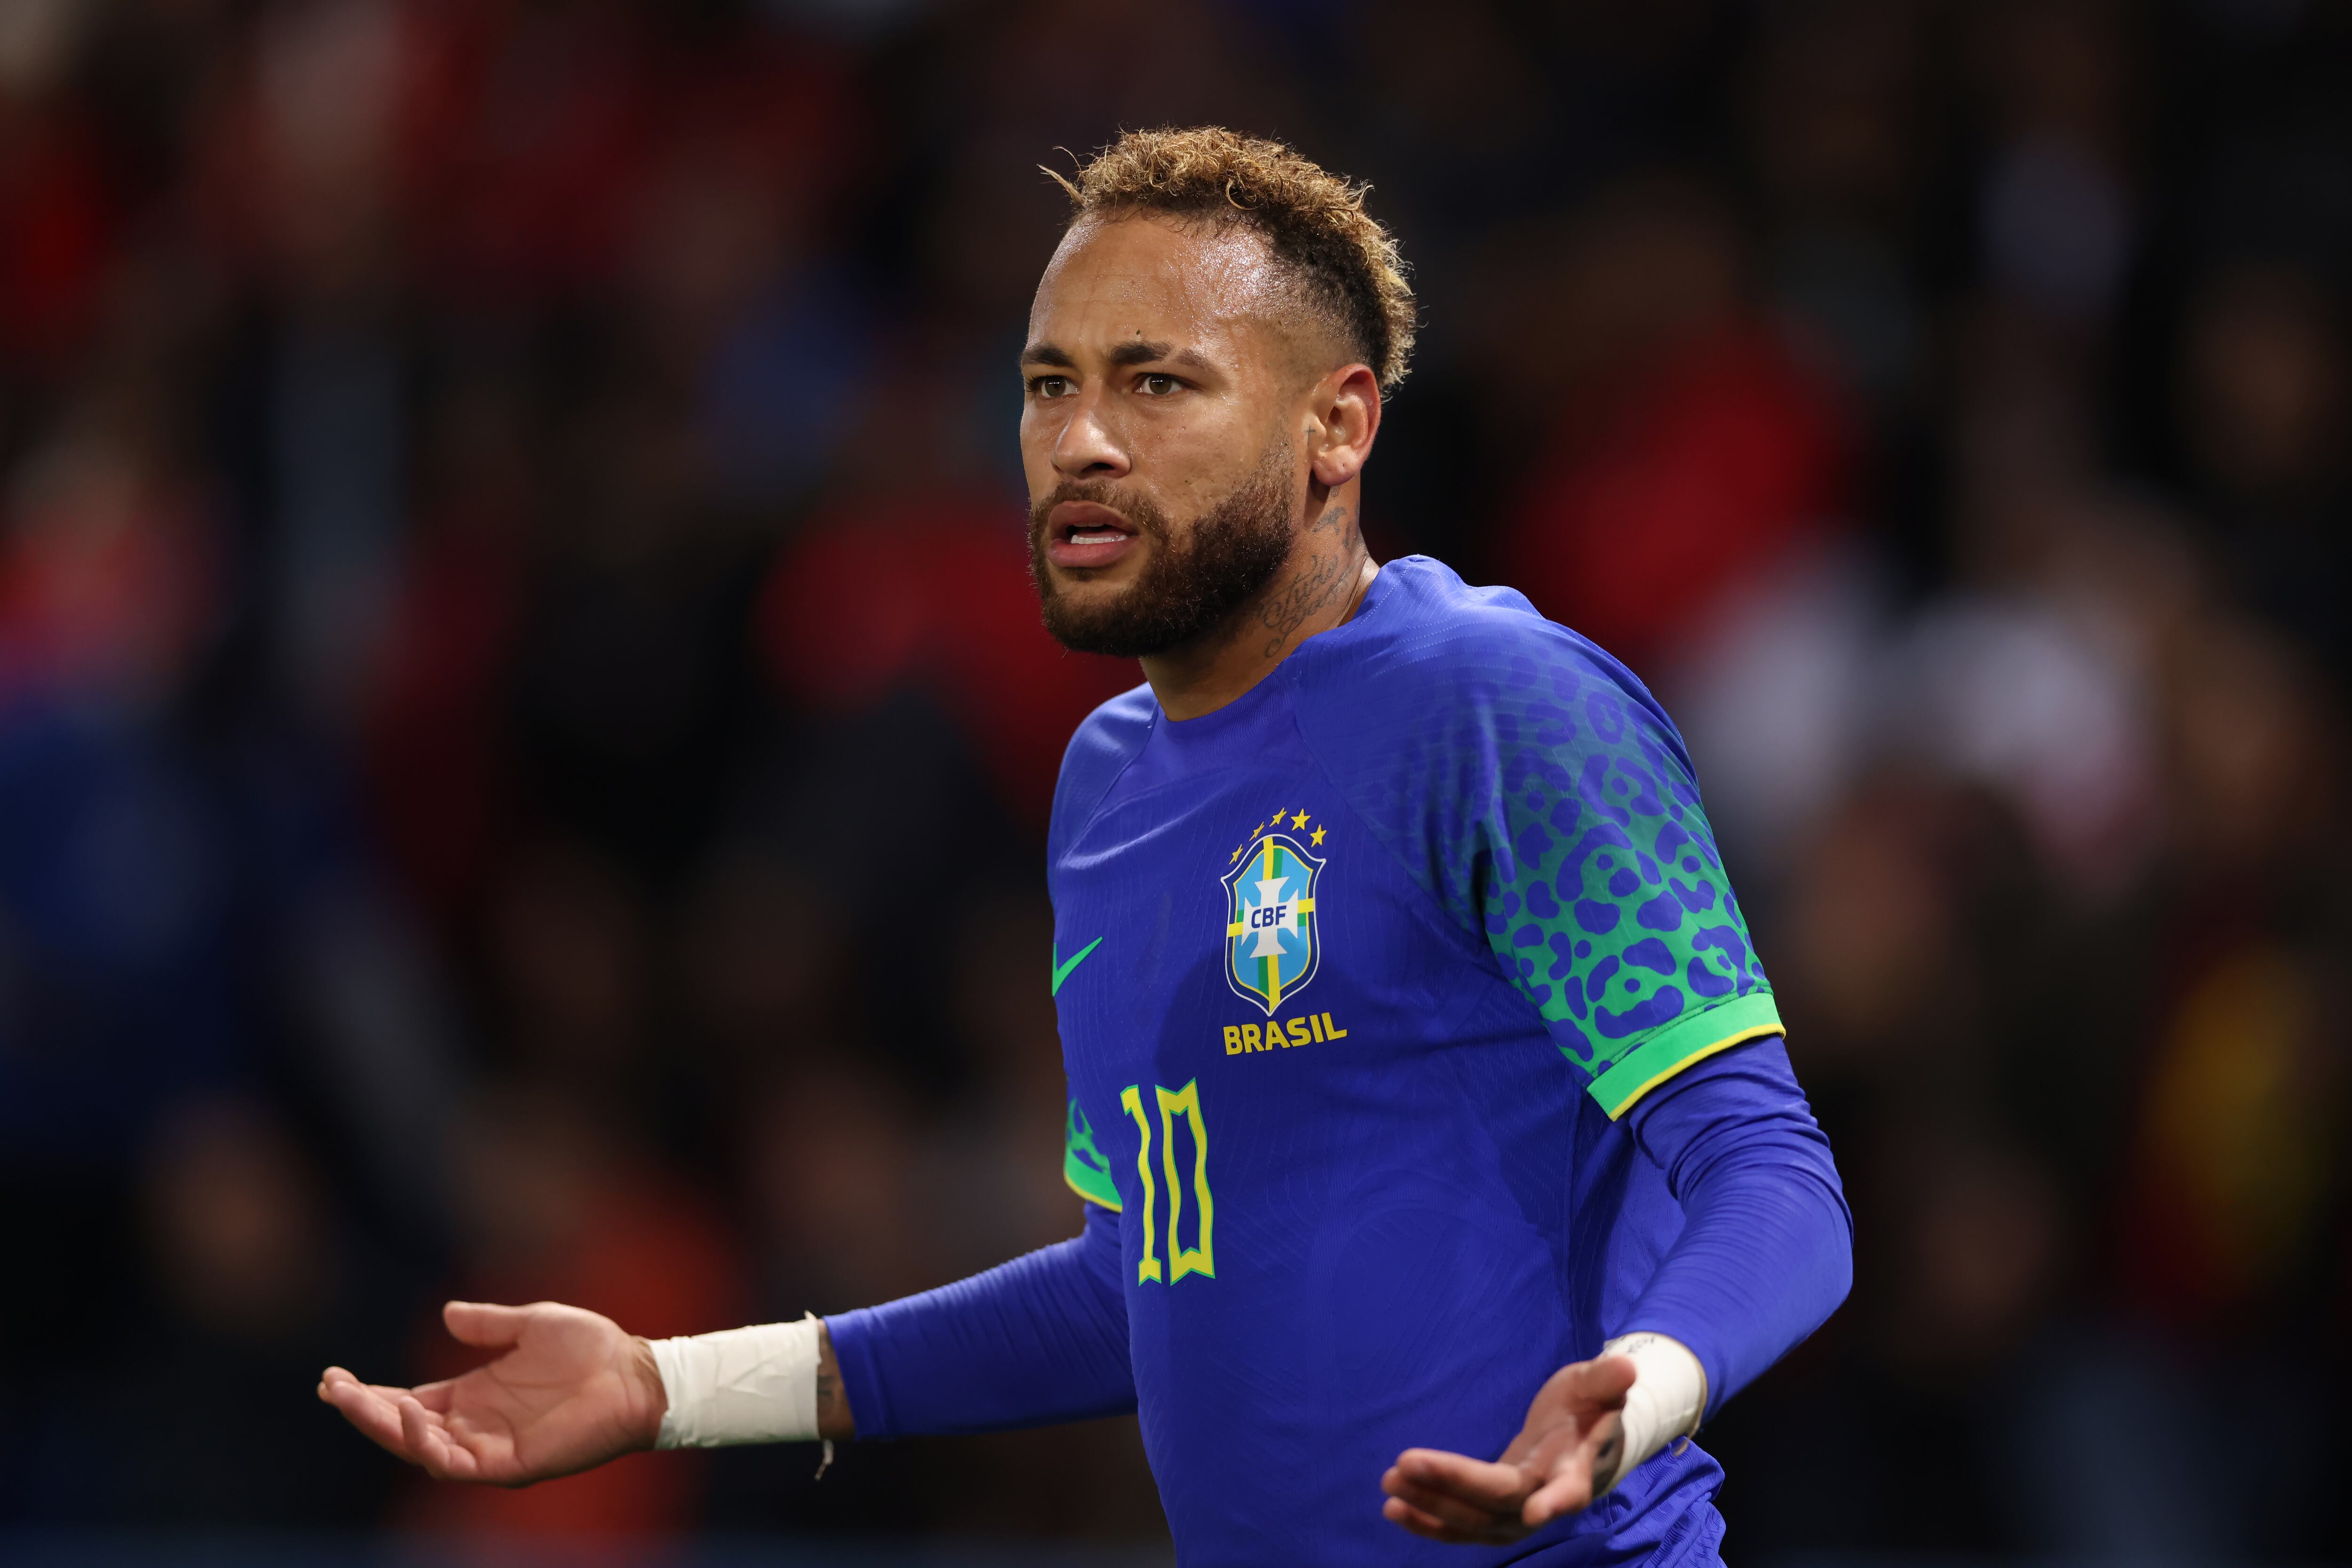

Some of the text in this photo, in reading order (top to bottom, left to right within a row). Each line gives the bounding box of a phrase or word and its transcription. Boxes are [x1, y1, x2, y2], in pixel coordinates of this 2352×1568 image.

[1251, 905, 1287, 929] CBF
[1223, 1012, 1348, 1056] BRASIL
[1120, 1077, 1216, 1287] 10
